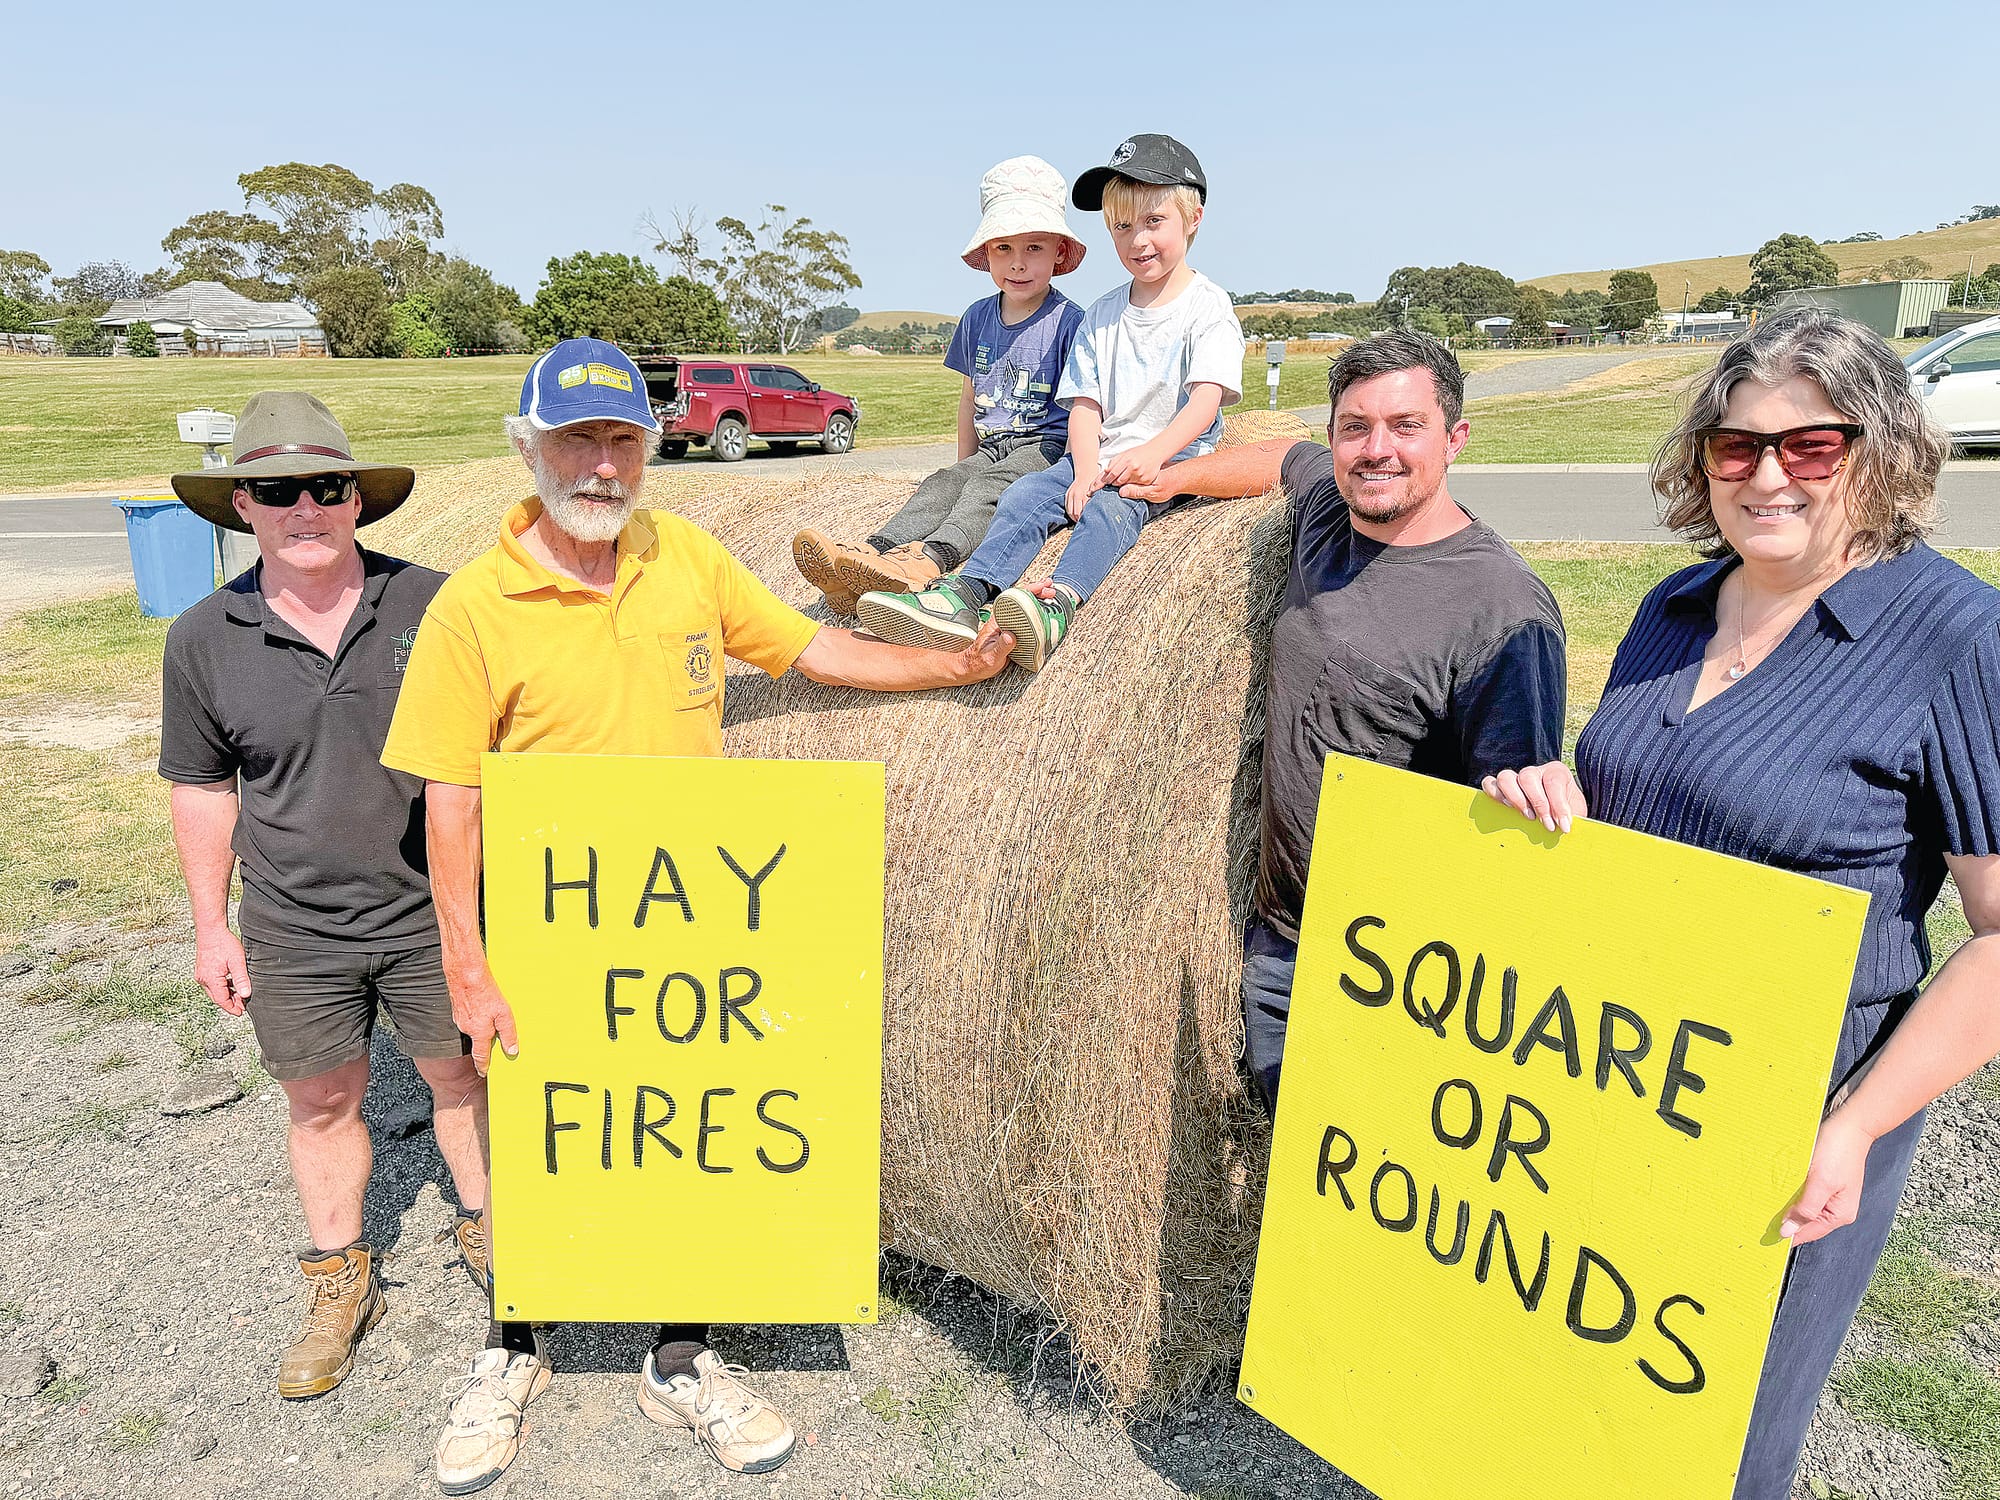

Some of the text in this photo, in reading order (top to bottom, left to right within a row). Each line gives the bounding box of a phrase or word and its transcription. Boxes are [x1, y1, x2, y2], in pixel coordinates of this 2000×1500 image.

[562, 367, 582, 380] 25
[685, 632, 707, 643] FRANK
[698, 657, 706, 670] L
[544, 842, 787, 932] HAY
[605, 966, 765, 1044] FOR
[1339, 915, 1734, 1139] SQUARE
[544, 1081, 810, 1176] FIRES
[1431, 1078, 1551, 1195] OR
[1316, 1125, 1706, 1395] ROUNDS
